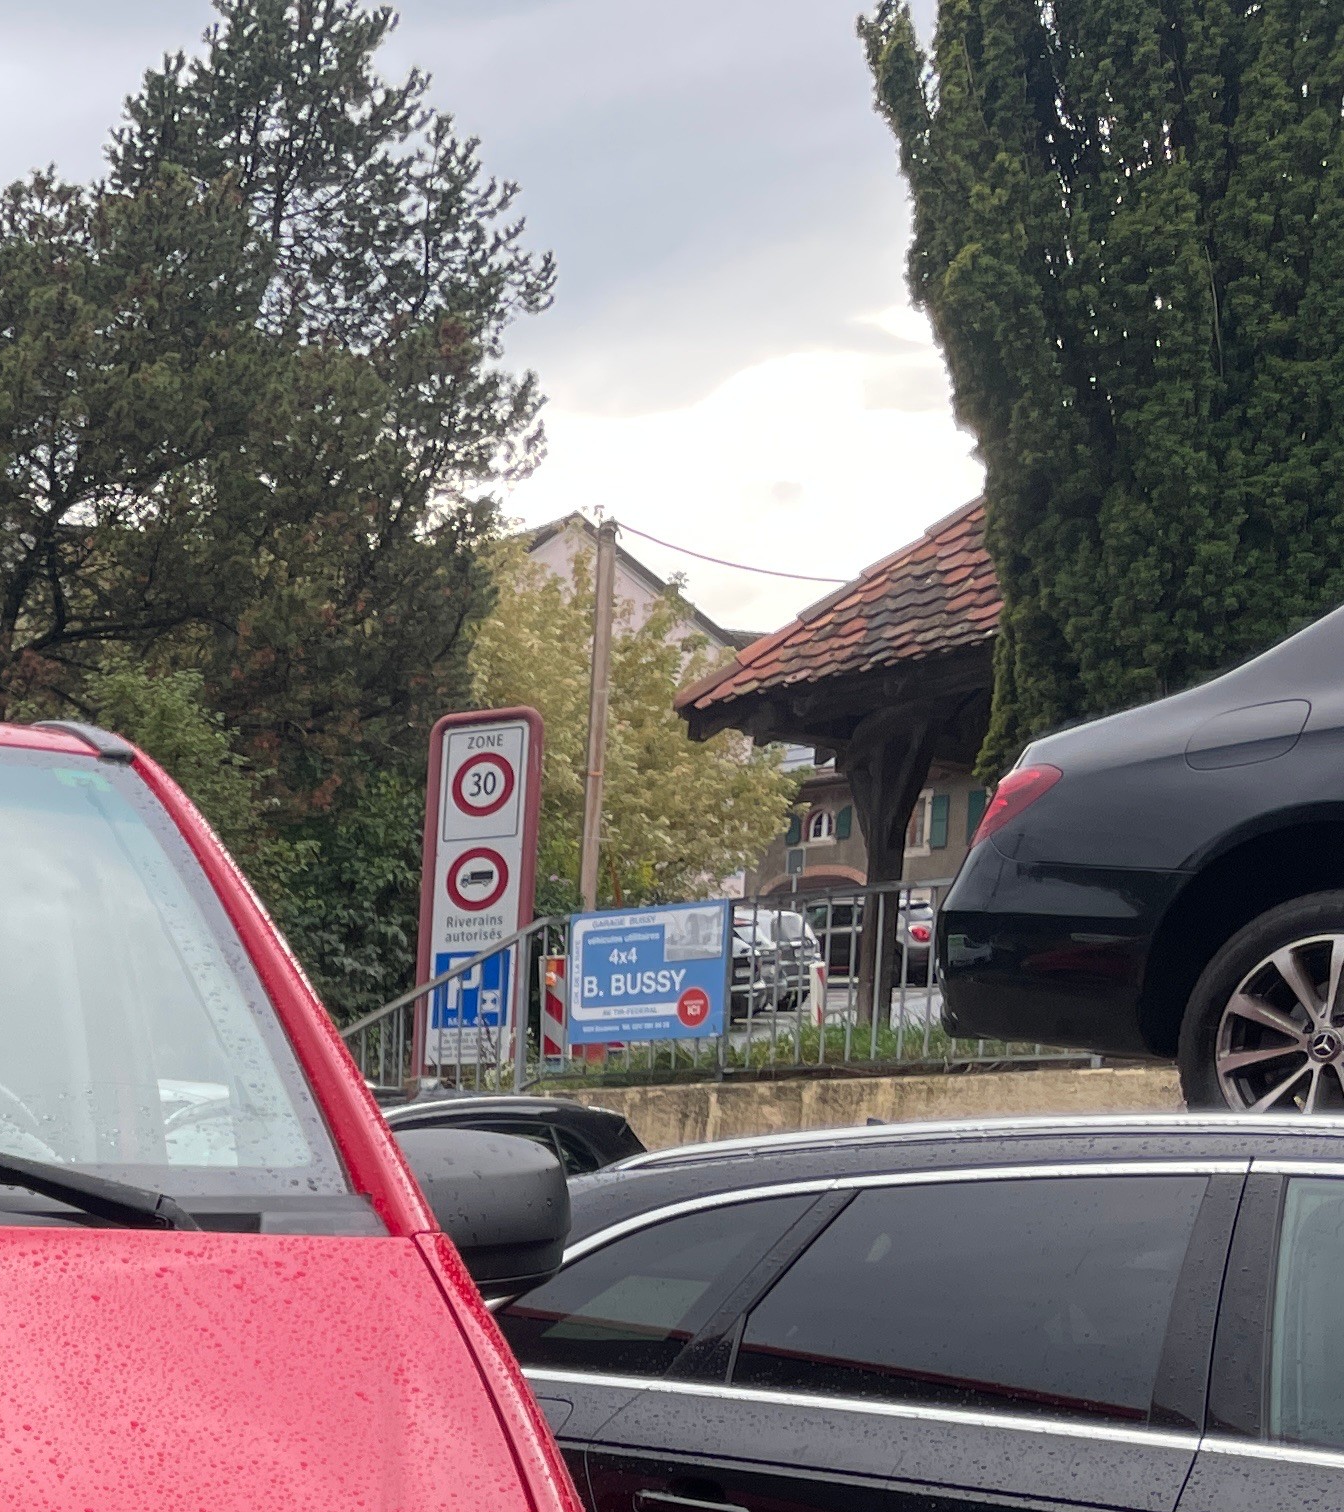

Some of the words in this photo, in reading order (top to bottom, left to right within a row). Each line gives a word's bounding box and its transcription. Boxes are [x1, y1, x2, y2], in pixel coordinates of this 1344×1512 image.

[467, 733, 504, 750] ZONE
[469, 771, 497, 797] 30
[446, 915, 503, 928] Riverains
[445, 930, 502, 943] autorisés
[608, 946, 638, 965] 4x4
[583, 975, 604, 998] B.
[611, 968, 687, 997] BUSSY
